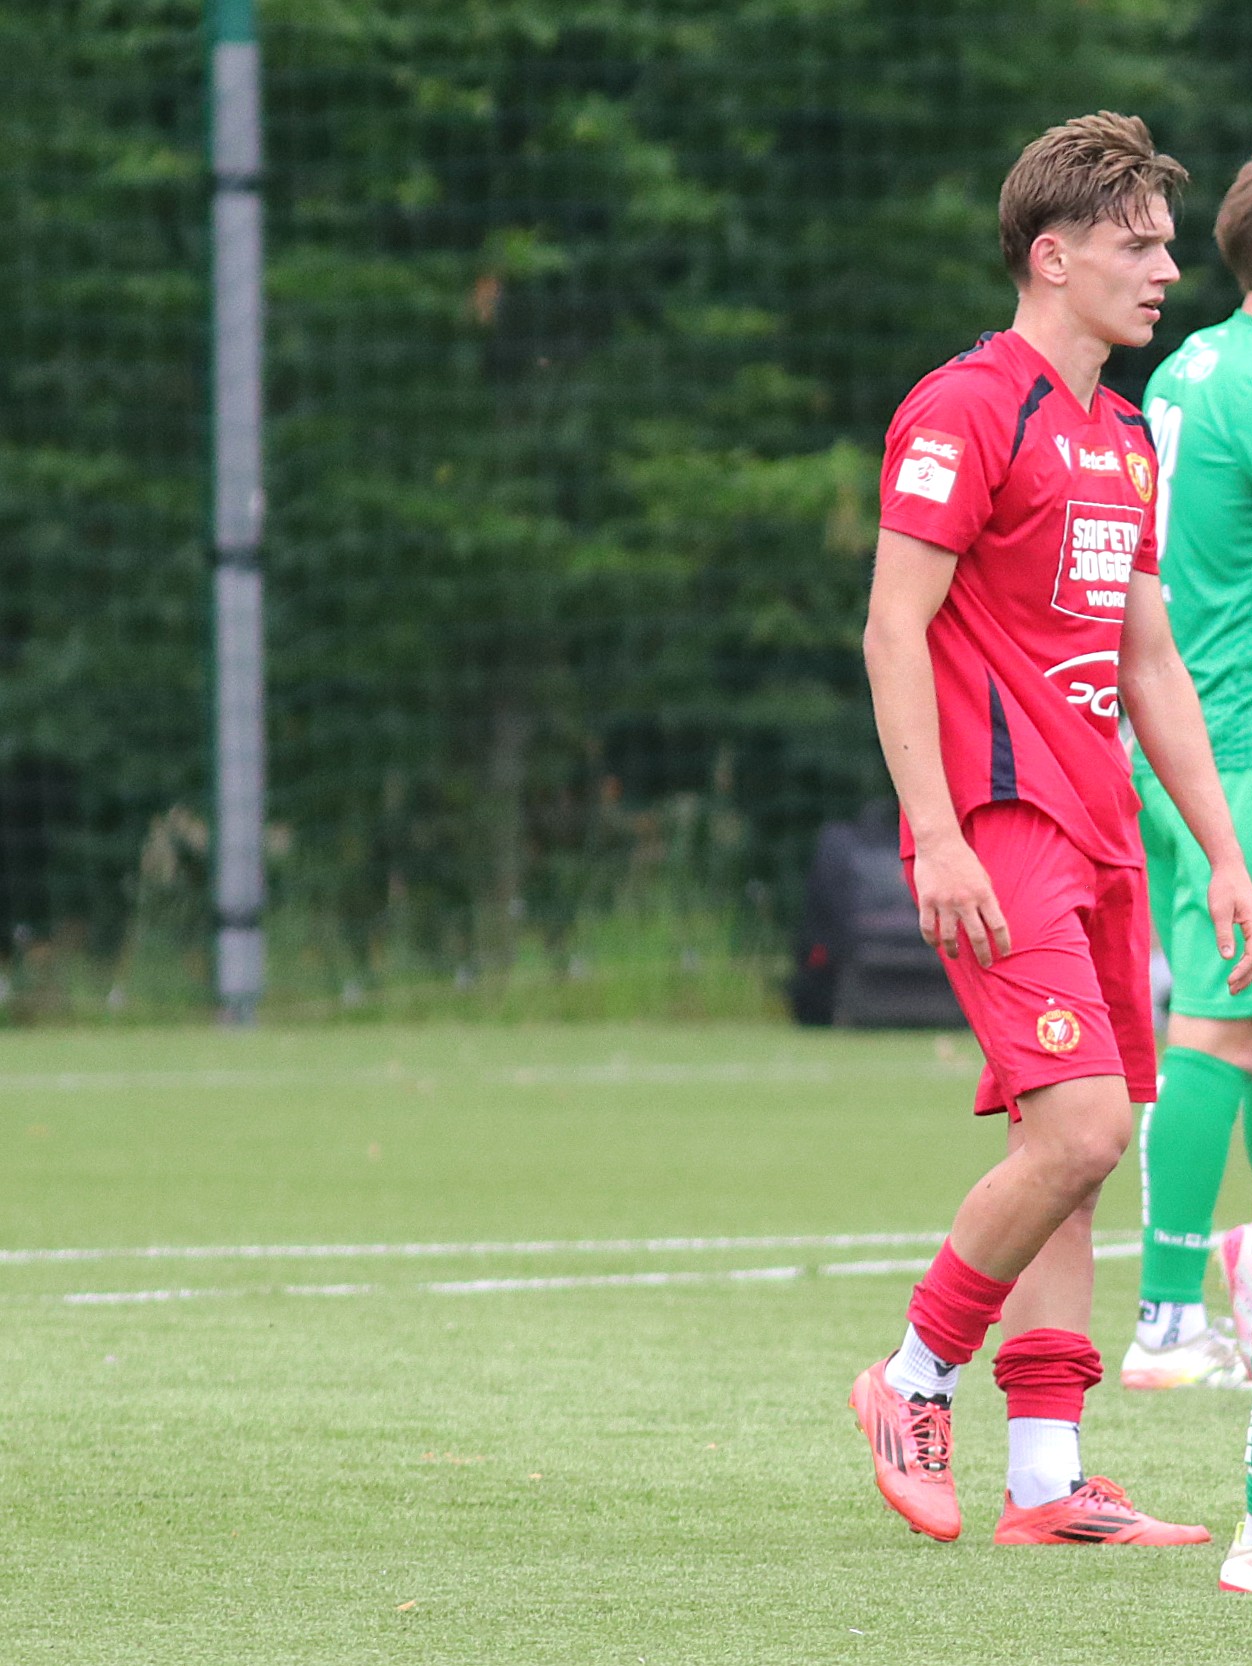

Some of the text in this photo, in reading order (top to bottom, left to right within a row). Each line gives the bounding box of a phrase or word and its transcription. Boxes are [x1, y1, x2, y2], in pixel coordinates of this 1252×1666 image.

[1072, 517, 1139, 554] SAFETY
[1069, 550, 1133, 583] JOGG
[1066, 681, 1119, 717] PG
